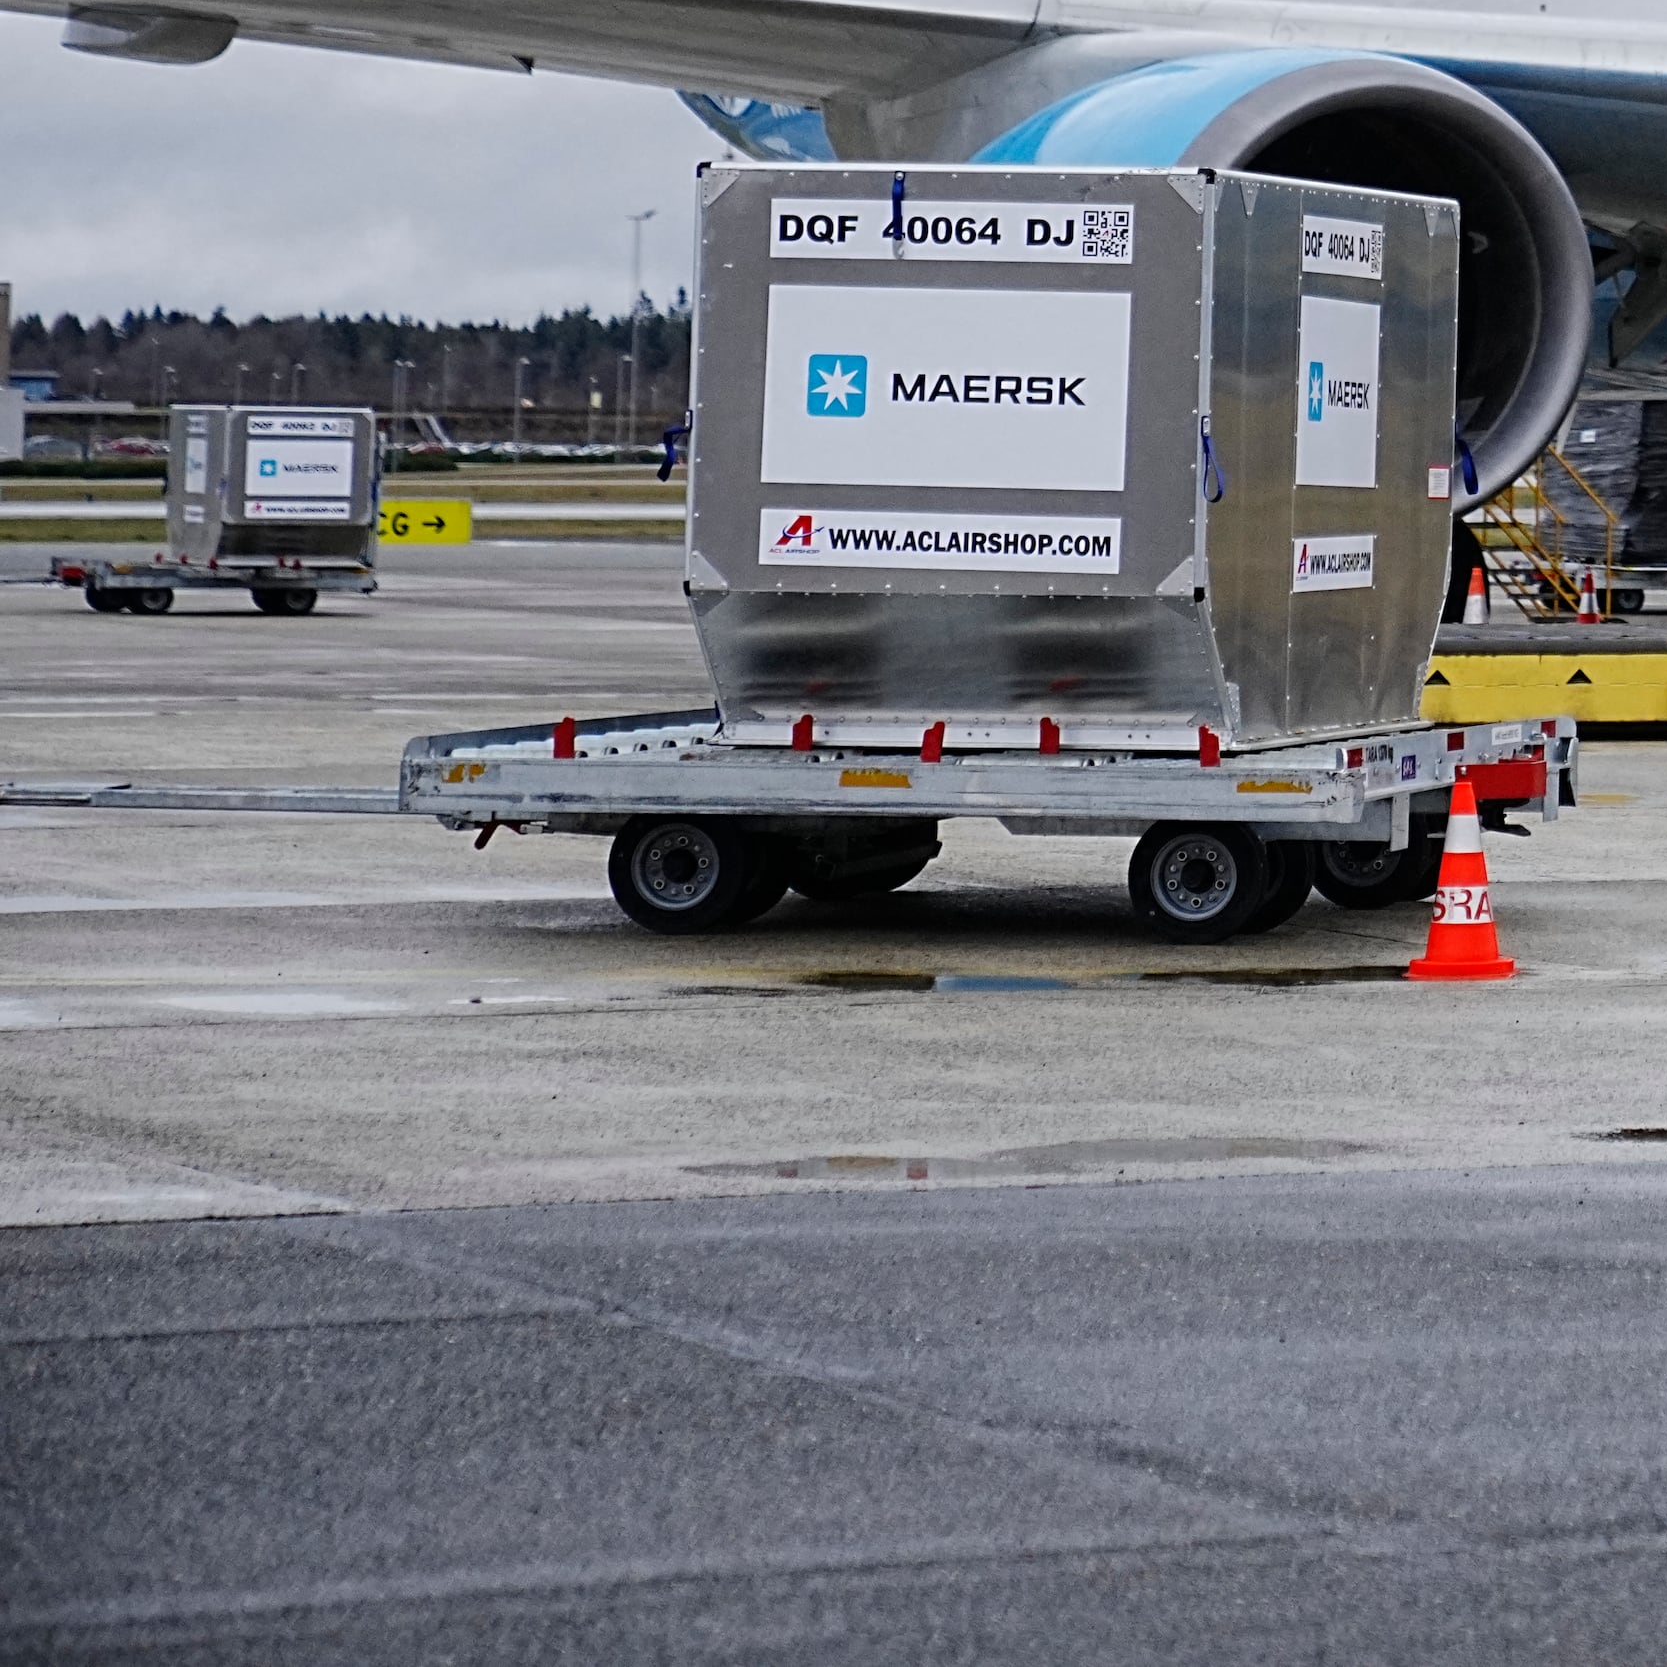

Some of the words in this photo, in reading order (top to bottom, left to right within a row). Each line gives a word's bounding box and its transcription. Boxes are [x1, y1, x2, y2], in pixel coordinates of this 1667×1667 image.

[779, 214, 859, 245] DQF
[1026, 218, 1075, 247] DJ
[1304, 230, 1323, 260] DQF
[1328, 233, 1354, 262] 40064
[1359, 237, 1370, 264] DJ
[892, 373, 1087, 406] MAERSK
[1328, 380, 1370, 410] MAERSK
[829, 528, 1111, 557] WWW.ACLAIRSHOP.COM
